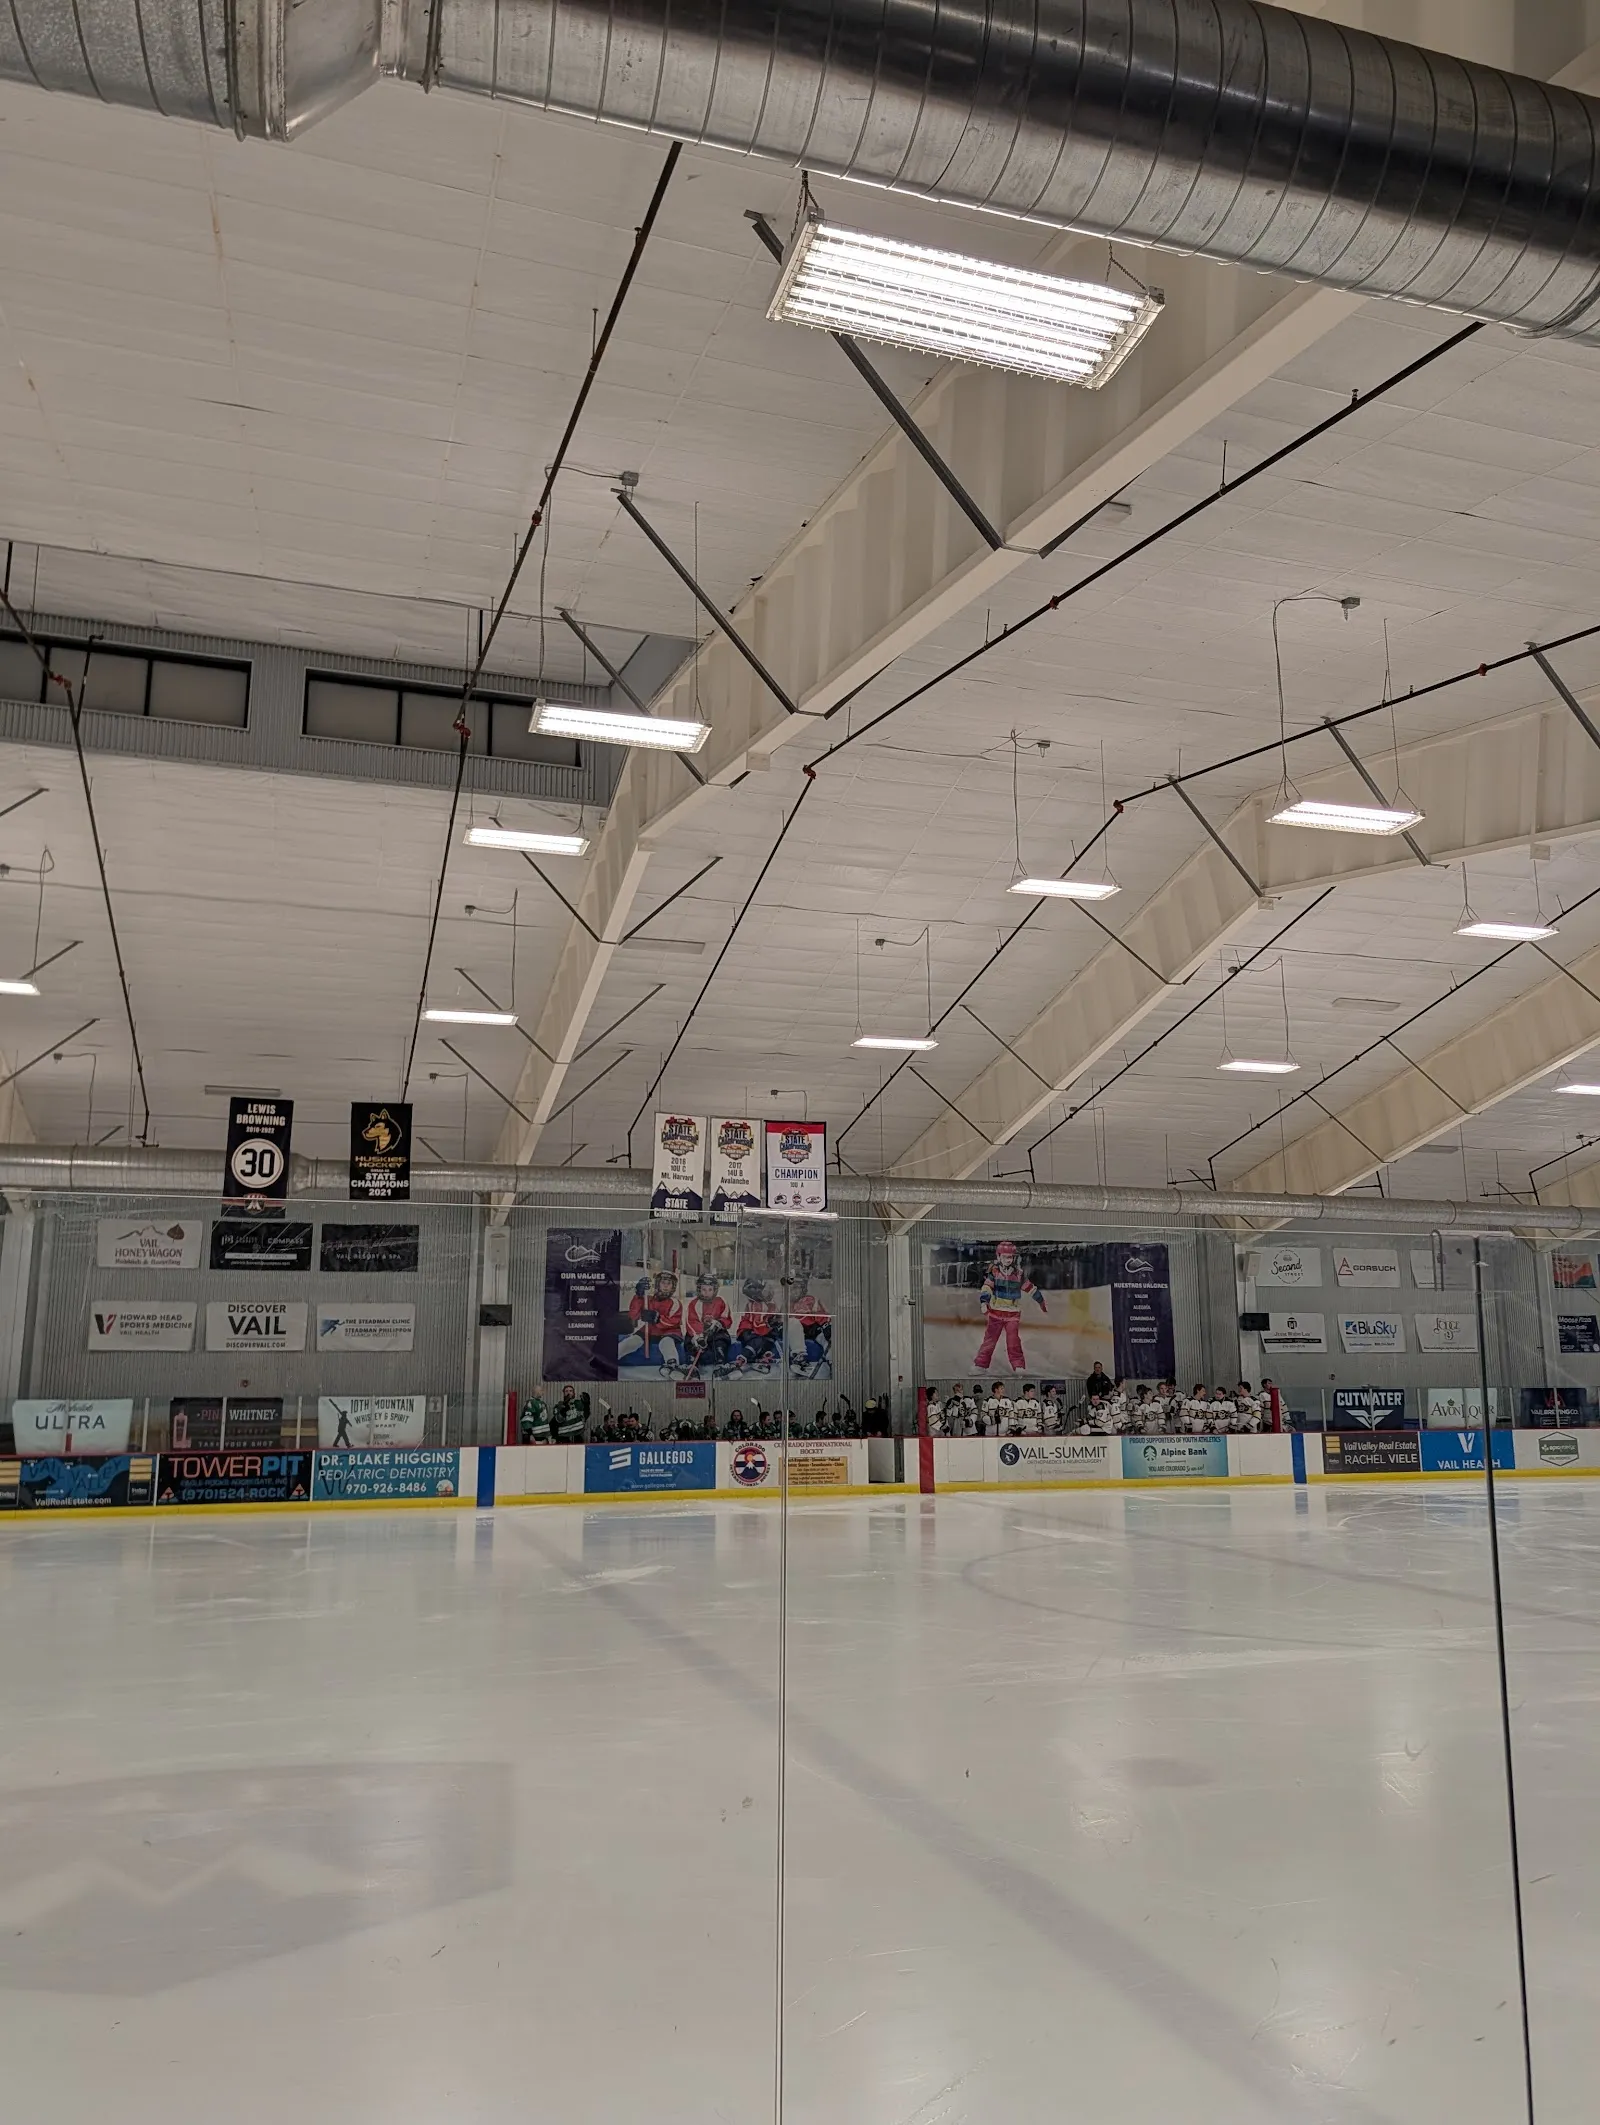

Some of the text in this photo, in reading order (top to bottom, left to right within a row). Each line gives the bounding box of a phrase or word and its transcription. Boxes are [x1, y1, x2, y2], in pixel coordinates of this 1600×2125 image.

[247, 1103, 276, 1114] LEWIS
[236, 1114, 286, 1126] BROWNING
[669, 1124, 693, 1136] STATE
[725, 1128, 748, 1140] STATE
[785, 1135, 806, 1145] STATE
[240, 1148, 275, 1178] 30
[728, 1161, 742, 1169] 2017
[365, 1172, 396, 1181] STATE
[672, 1172, 694, 1182] Harvard
[774, 1168, 818, 1179] CHAMPION
[351, 1180, 409, 1188] CHAMPIONS
[720, 1176, 750, 1185] Avalanche
[368, 1188, 392, 1197] 2021
[664, 1197, 689, 1210] STATE
[139, 1239, 160, 1248] VAIL
[115, 1248, 184, 1258] HONEYWAGON
[1270, 1258, 1303, 1275] Second
[1352, 1264, 1397, 1272] GORSUCH
[560, 1272, 606, 1280] OUR VALUES
[227, 1304, 287, 1313] DISCOVER
[227, 1315, 287, 1335] VAIL
[1358, 1320, 1397, 1338] BluSky
[677, 1385, 705, 1395] HOME
[1336, 1391, 1402, 1406] CUTWATER
[350, 1398, 370, 1414] 10TH
[1430, 1402, 1461, 1417] AVON
[229, 1409, 276, 1421] WHITNEY
[390, 1412, 410, 1424] SPIRIT
[35, 1415, 106, 1430] ULTRA
[734, 1442, 766, 1453] COLORADO
[1161, 1447, 1208, 1457] Alpine Bank
[1344, 1441, 1417, 1453] Vail Valley Real Estate
[639, 1450, 694, 1465] GALLEGOS
[1019, 1446, 1118, 1460] VAIL-SUMMIT
[1345, 1453, 1418, 1464] RACHEL VIELE
[321, 1452, 454, 1466] DR. BLAKE HIGGINS
[1437, 1460, 1460, 1469] VAIL
[318, 1467, 456, 1481] PEDIATRIC DENTISTRY
[345, 1482, 427, 1494] 970-926-8486
[35, 1498, 112, 1507] VailRealEstate.com
